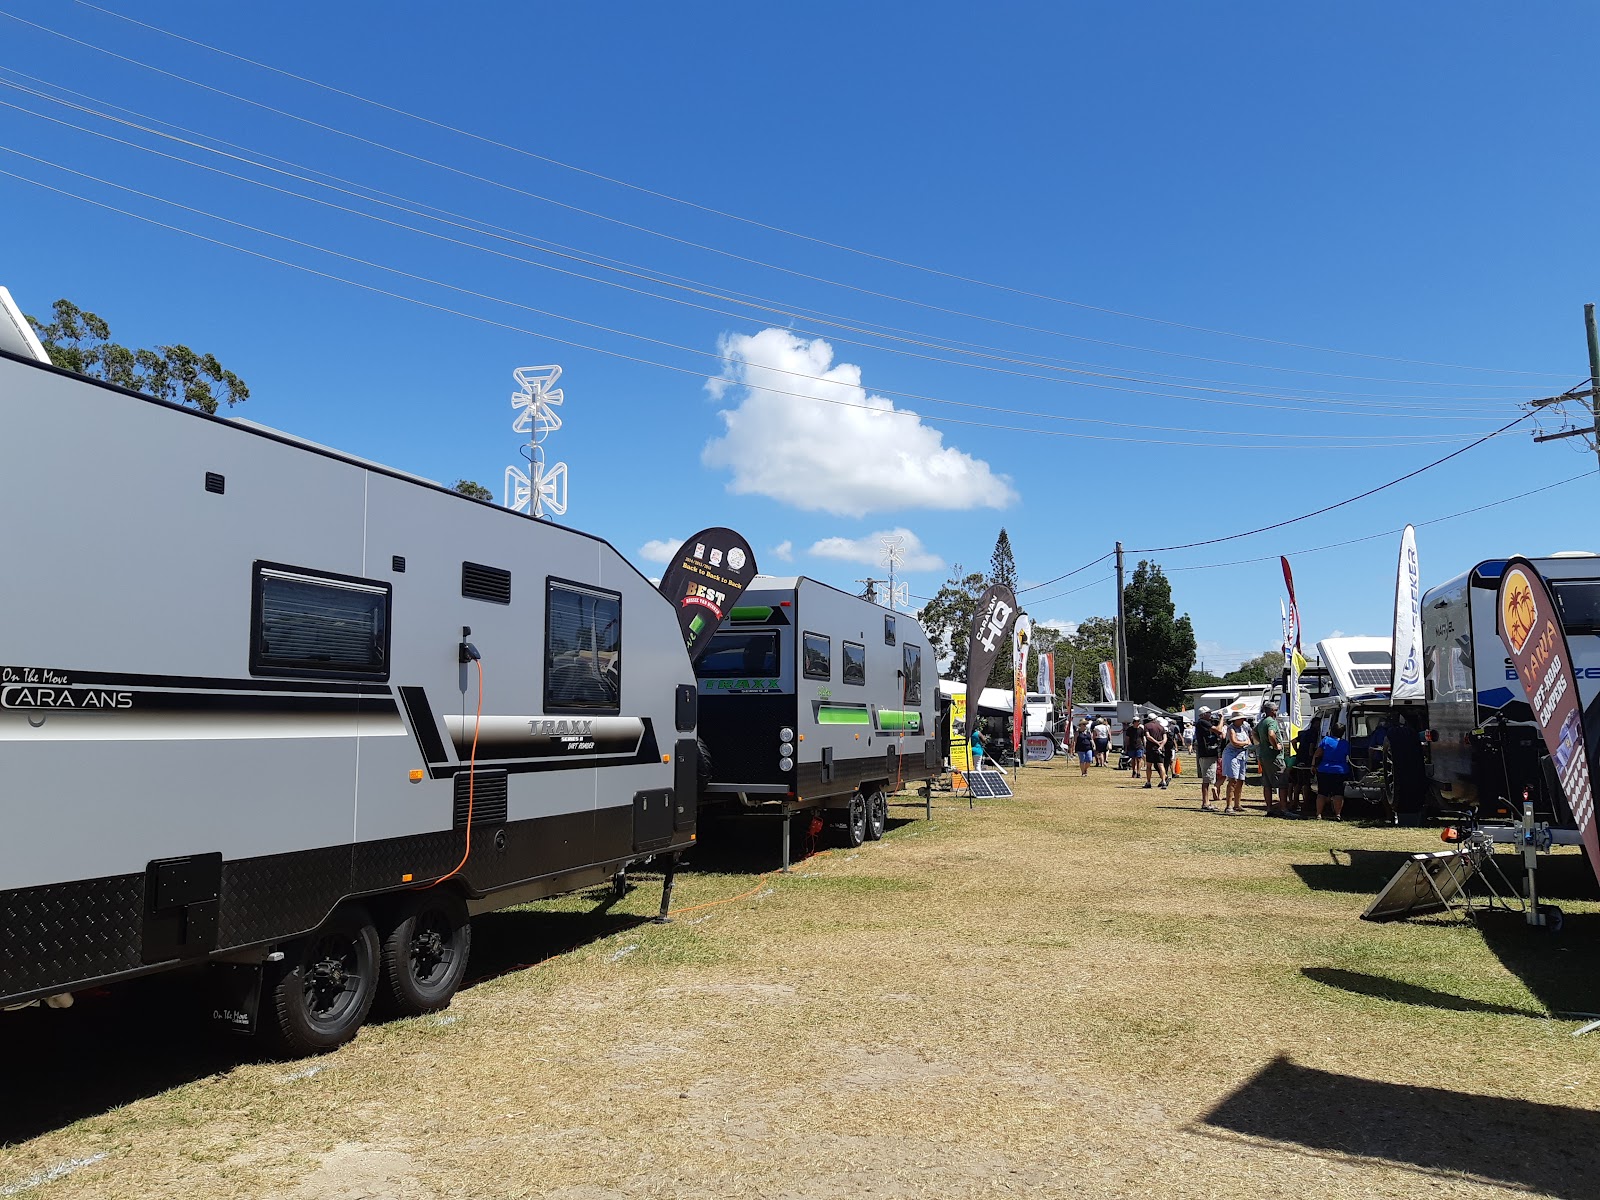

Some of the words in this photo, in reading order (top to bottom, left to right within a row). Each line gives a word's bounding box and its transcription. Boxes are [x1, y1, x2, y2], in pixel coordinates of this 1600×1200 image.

[682, 562, 699, 573] Back
[706, 571, 721, 582] Back
[728, 579, 743, 589] Back
[686, 581, 726, 607] BEST
[976, 595, 998, 641] CARAVAN
[981, 600, 1013, 653] HQ
[1523, 619, 1558, 692] JAWA
[2, 667, 20, 683] On
[23, 668, 39, 683] The
[42, 669, 68, 684] Move
[705, 679, 780, 690] TRAXX
[1533, 654, 1562, 712] OFF-ROAD
[1, 686, 133, 709] CARAANS
[1539, 673, 1568, 728] CAMPERS
[528, 720, 593, 736] TRAXX
[213, 1010, 223, 1019] On
[224, 1010, 233, 1019] The
